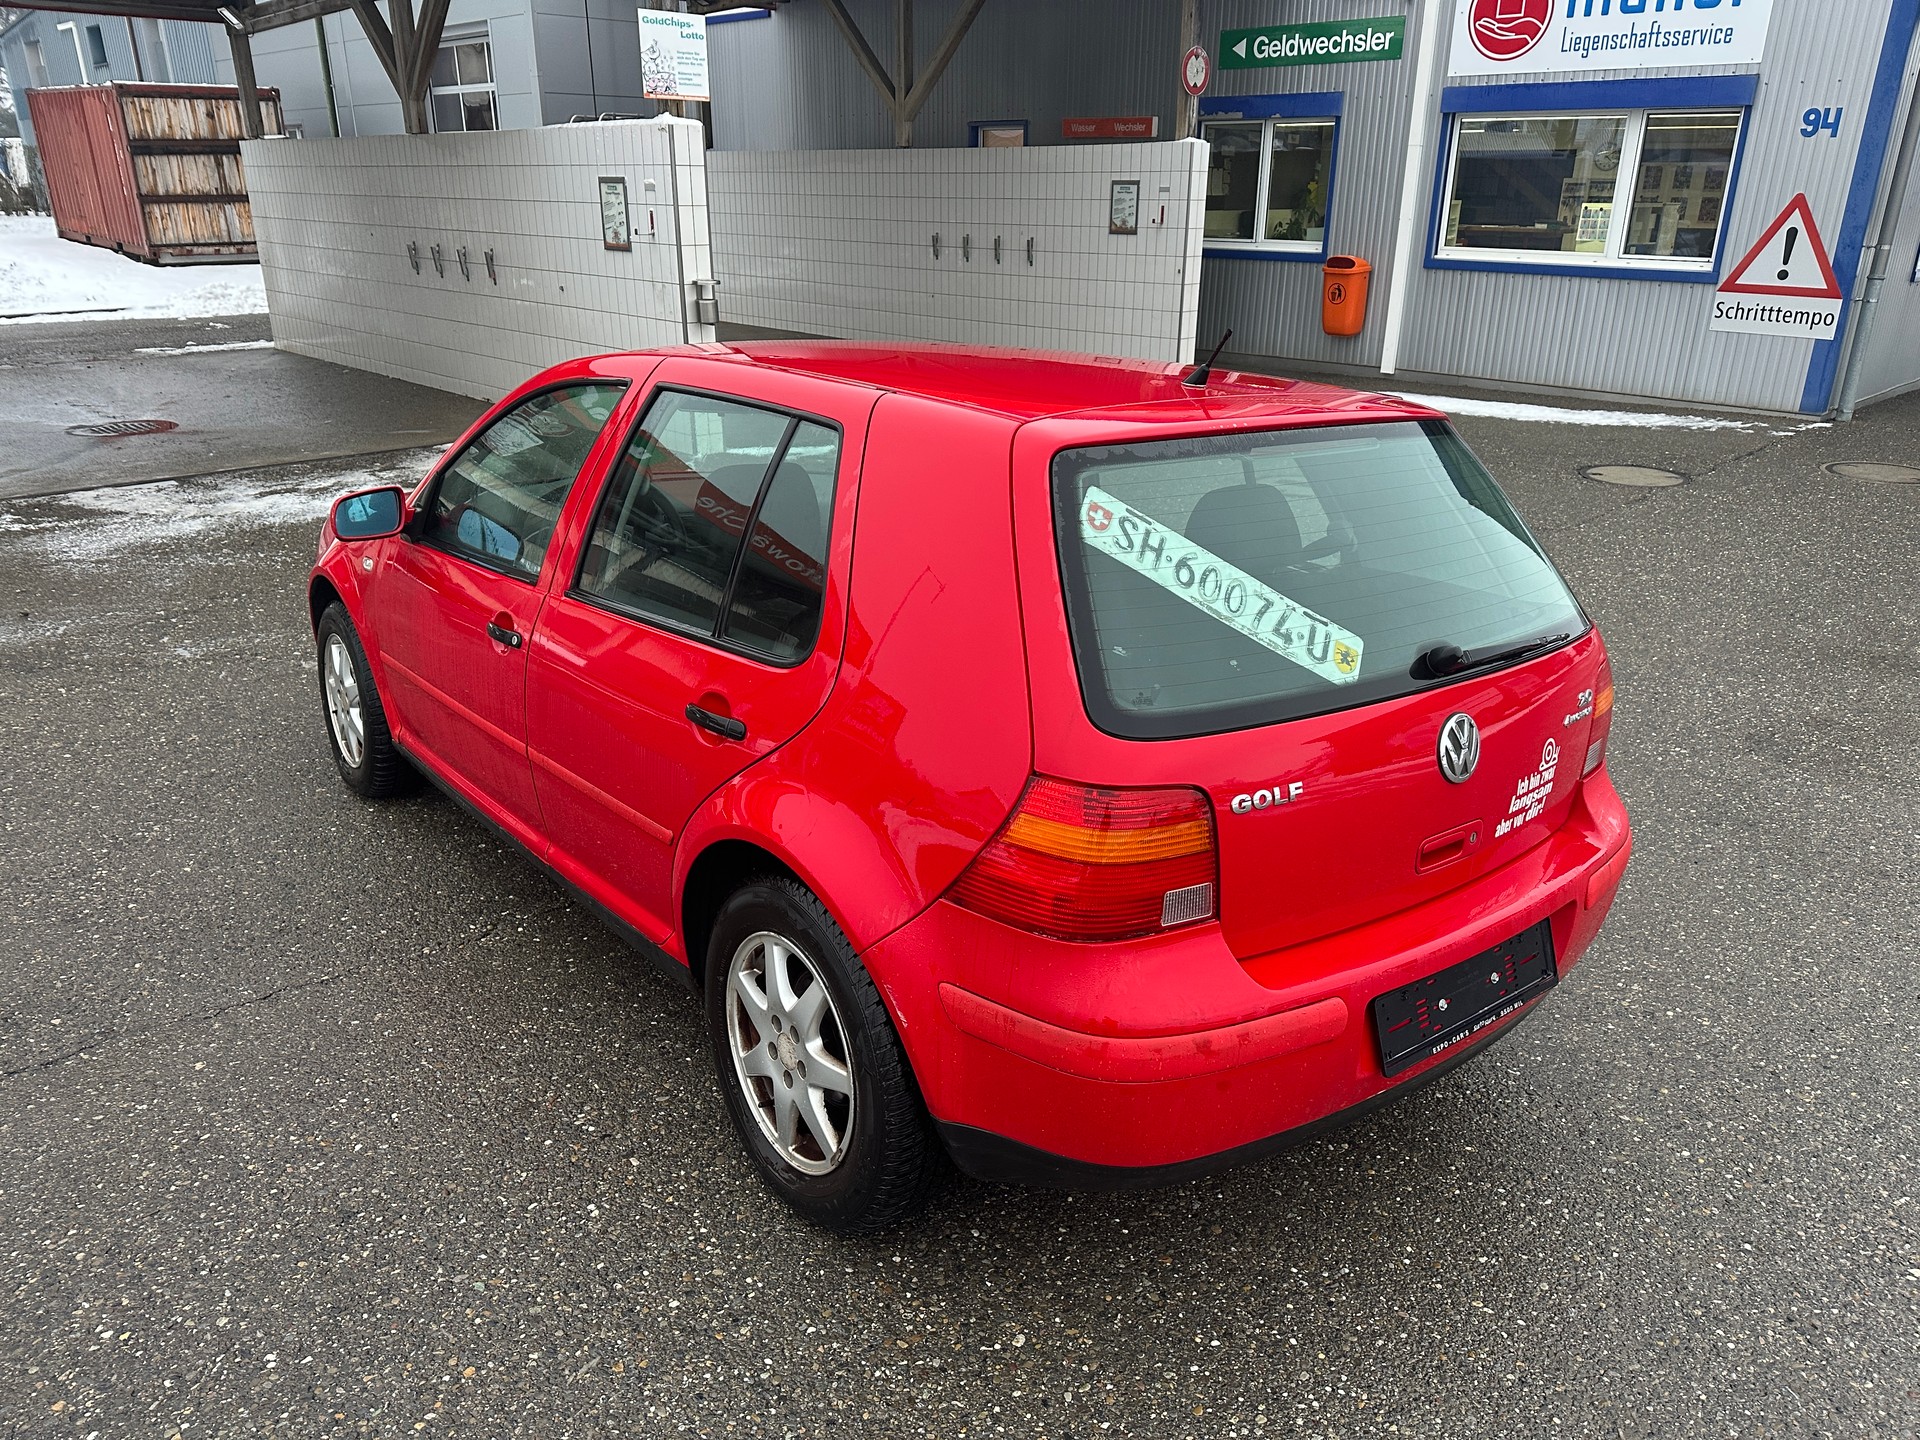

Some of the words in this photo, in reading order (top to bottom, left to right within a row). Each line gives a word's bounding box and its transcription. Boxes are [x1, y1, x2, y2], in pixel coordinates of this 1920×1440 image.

[642, 16, 694, 29] GoldChips-
[680, 31, 704, 40] Lotto
[1253, 28, 1395, 59] Geldwechsler
[1560, 20, 1734, 59] Liegenschaftsservice
[1071, 124, 1096, 132] Wasser
[1114, 122, 1146, 132] Wechsler
[1800, 107, 1843, 138] 94
[1714, 301, 1835, 330] Schritttempo
[1540, 765, 1556, 783] zwar
[1231, 781, 1304, 814] GOLF
[1508, 781, 1553, 815] langsam
[1495, 818, 1513, 838] aber
[1513, 812, 1525, 828] vor
[1525, 796, 1546, 821] dir!
